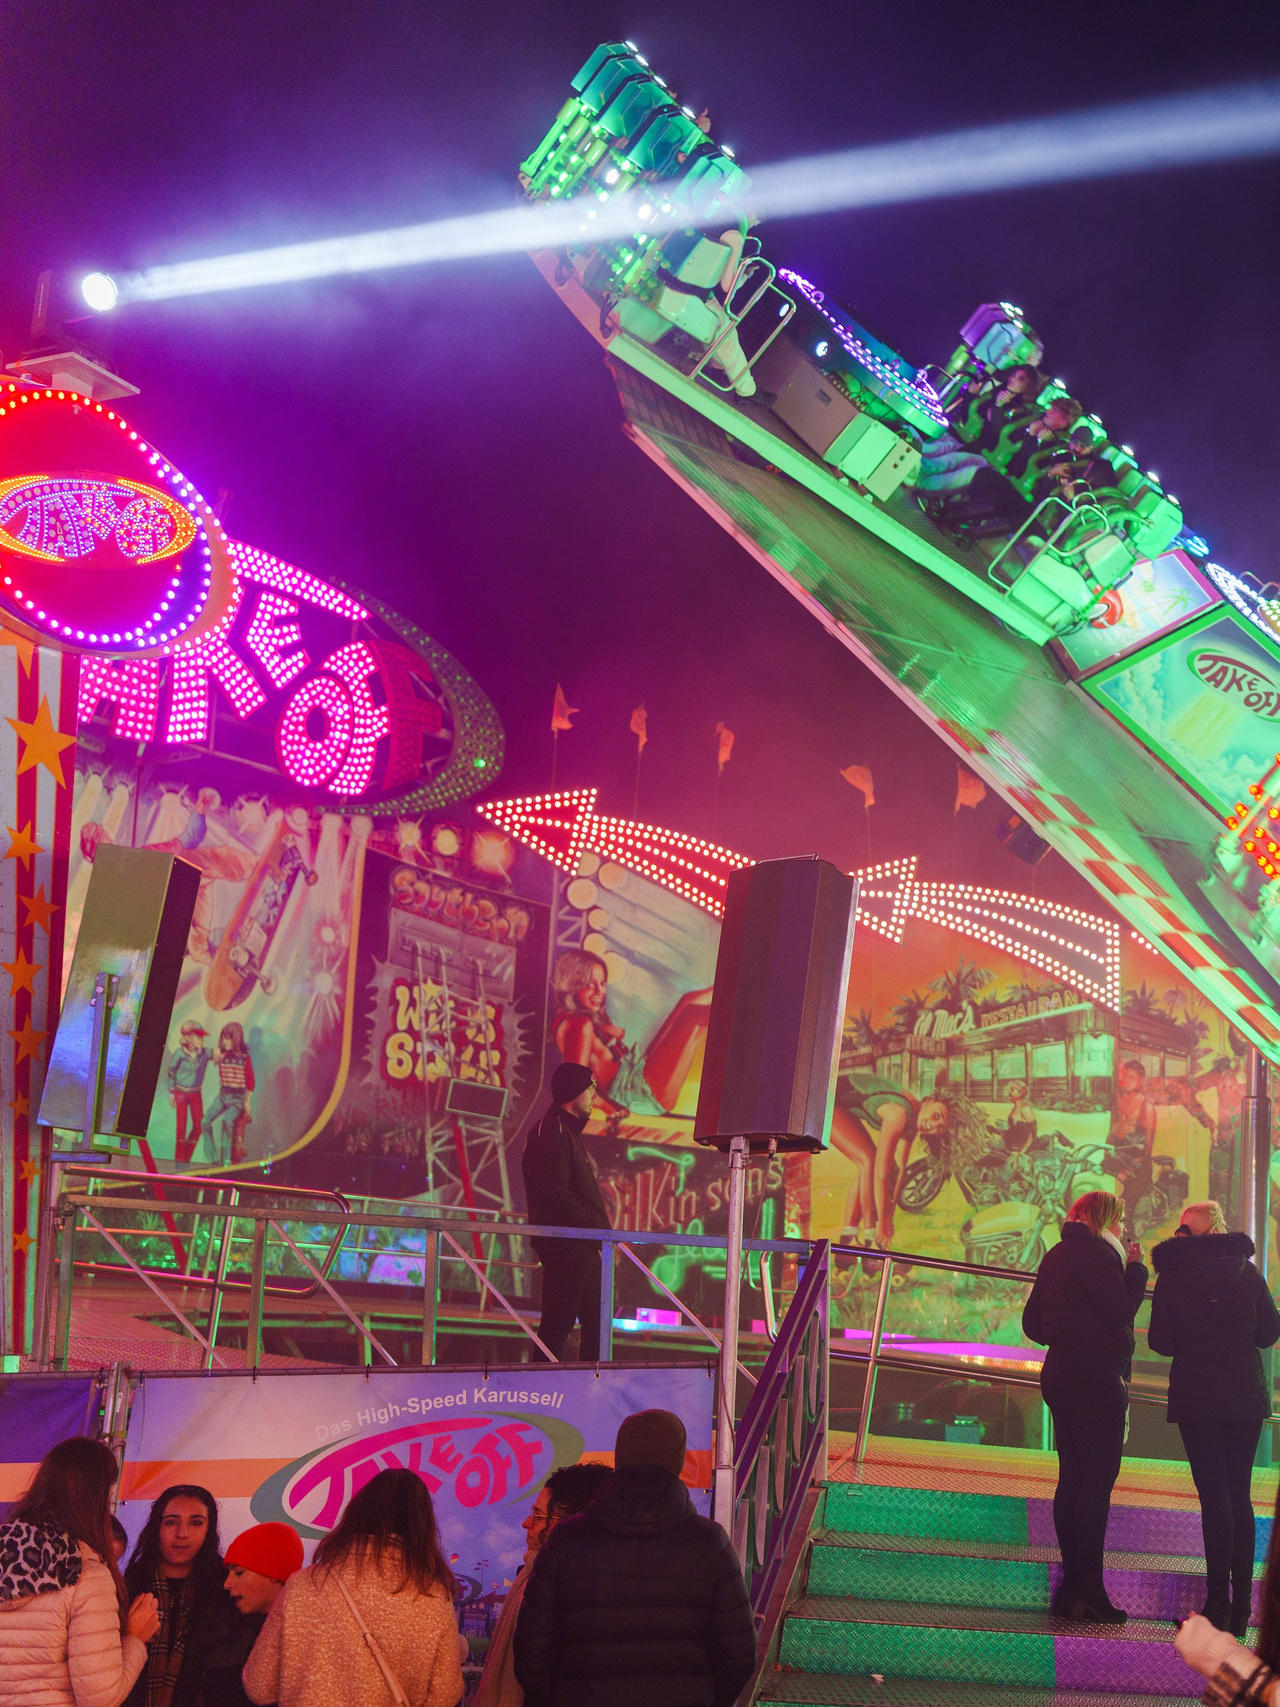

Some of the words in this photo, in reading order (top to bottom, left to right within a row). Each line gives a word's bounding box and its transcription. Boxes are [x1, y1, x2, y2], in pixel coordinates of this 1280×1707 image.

[1196, 654, 1278, 693] TAKE
[274, 639, 443, 797] OFF
[981, 989, 1080, 1028] RESTAURAN
[314, 1417, 353, 1442] Das
[356, 1389, 468, 1427] High-Speed
[473, 1386, 565, 1409] Karussell
[454, 1422, 544, 1508] OFF
